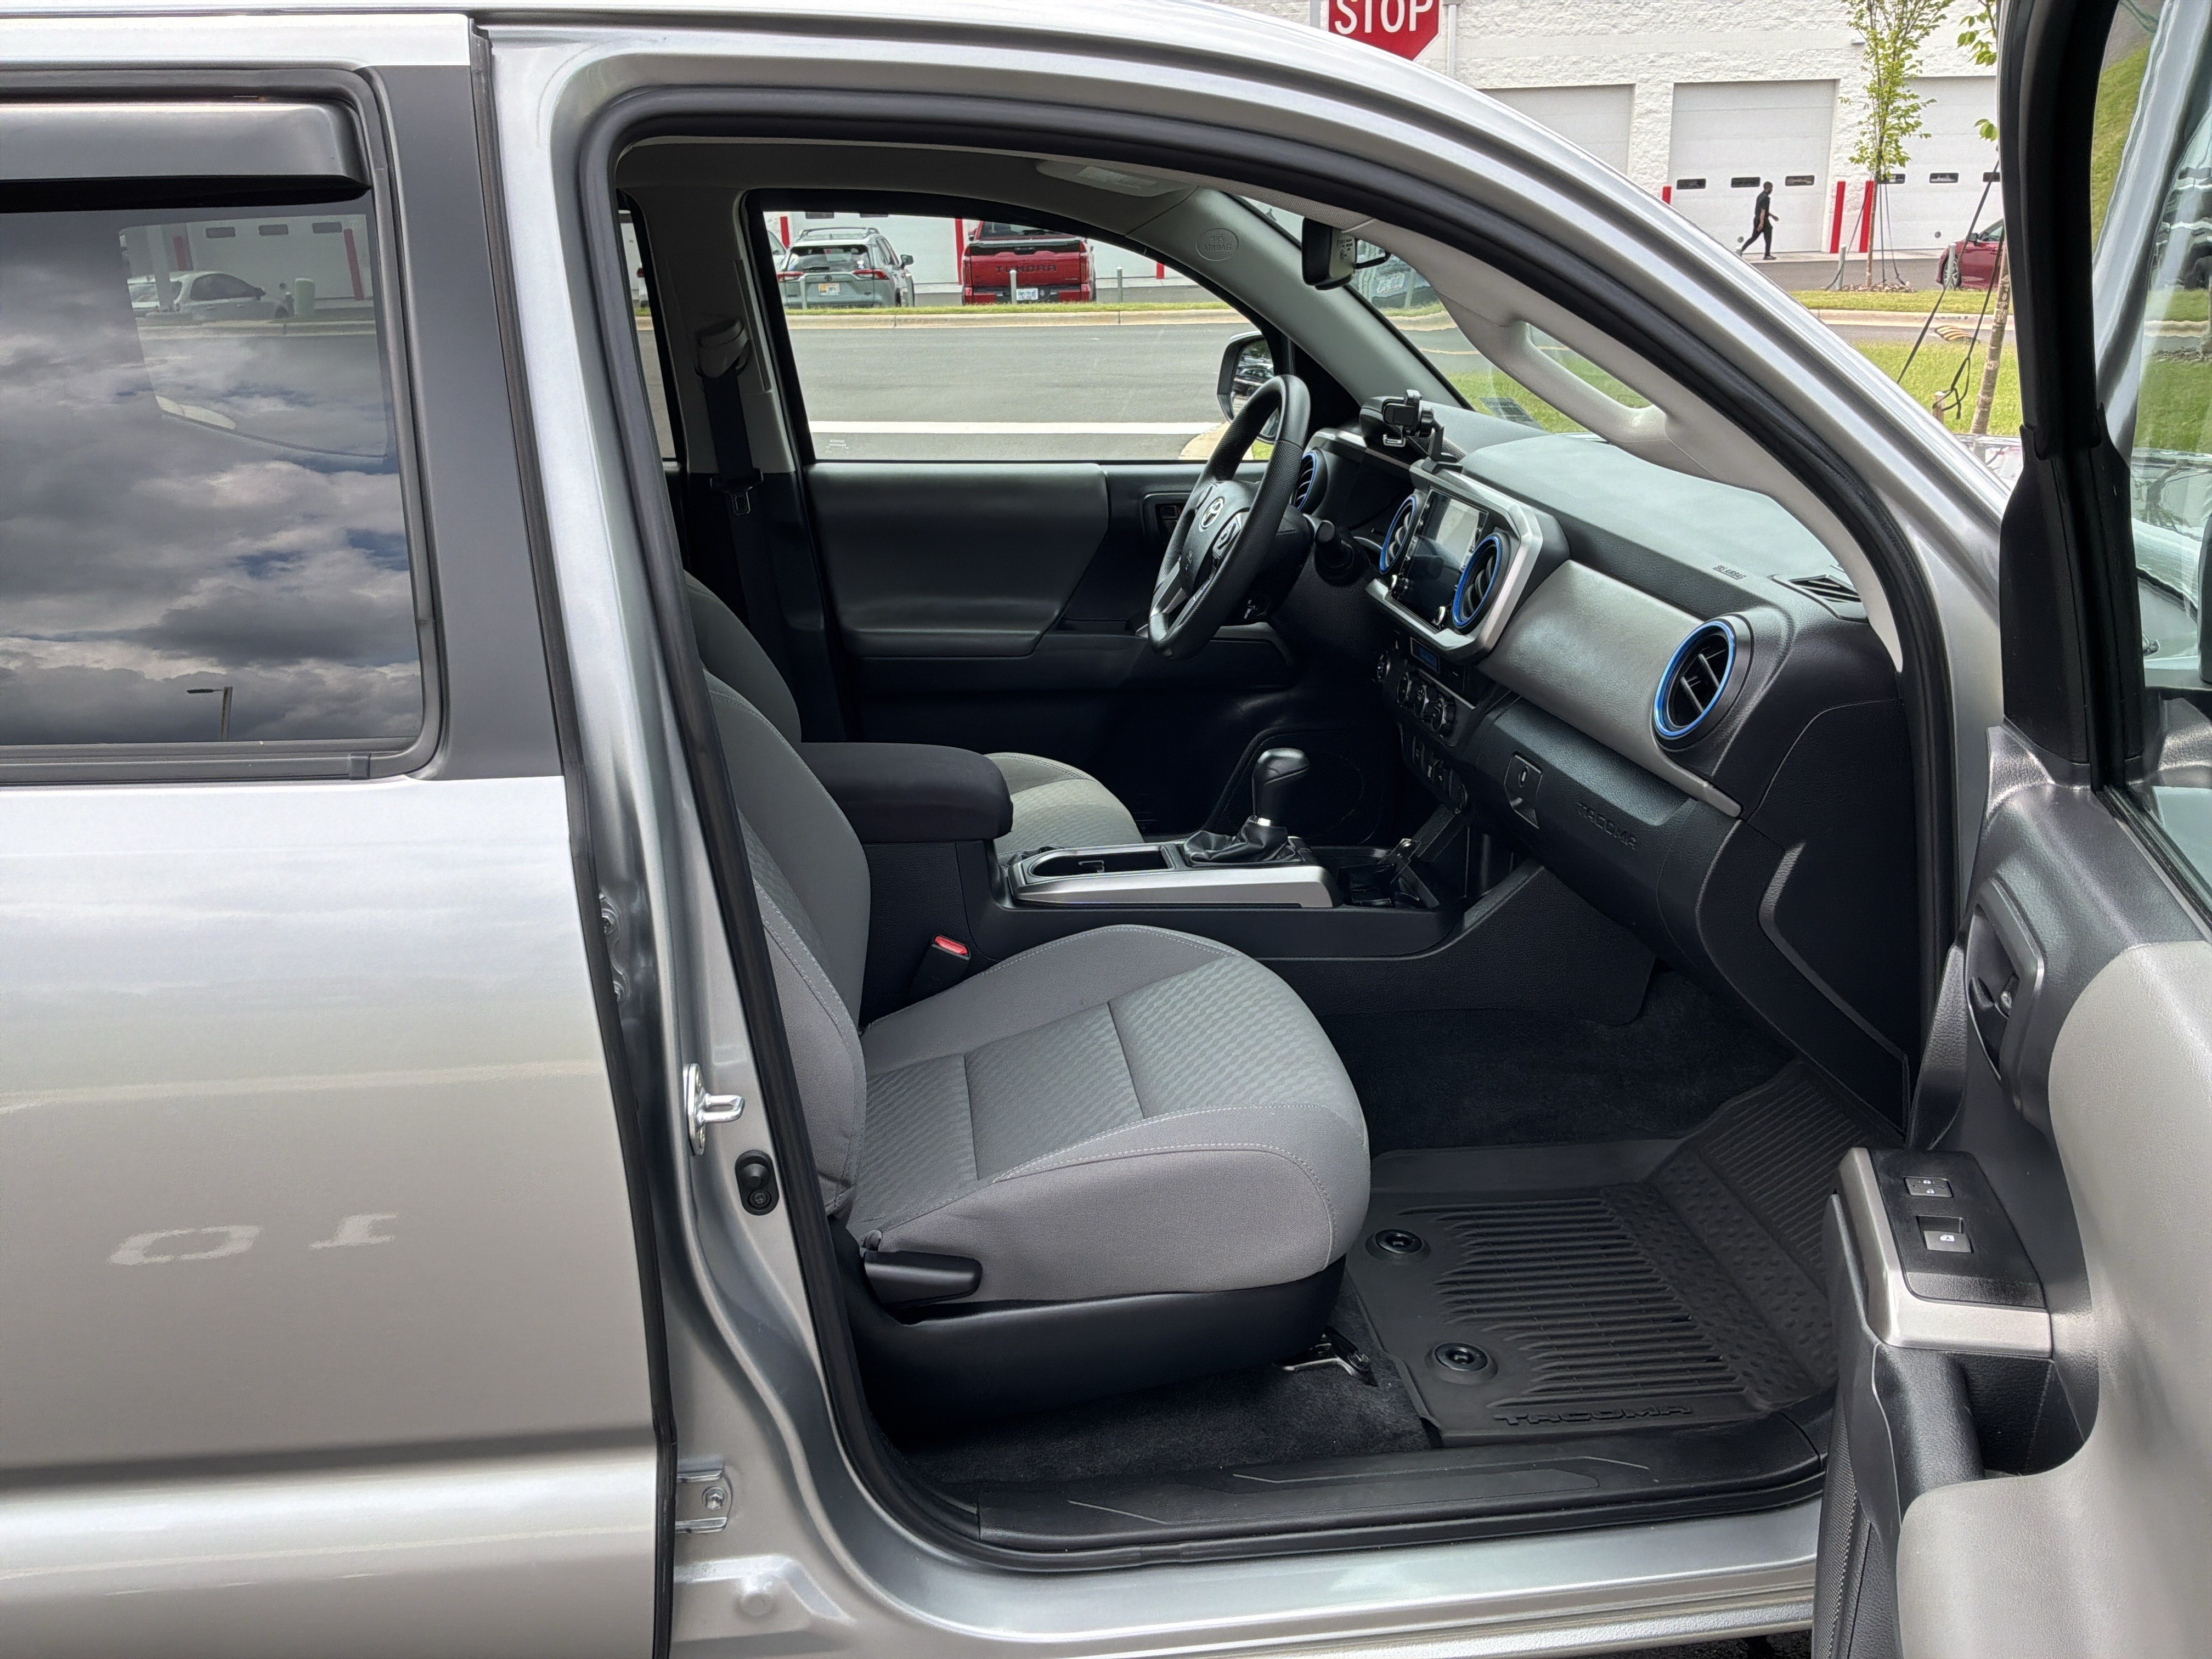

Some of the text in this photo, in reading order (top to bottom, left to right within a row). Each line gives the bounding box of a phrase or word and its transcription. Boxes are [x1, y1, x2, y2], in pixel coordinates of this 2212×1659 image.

[1334, 0, 1433, 35] STOP
[995, 264, 1057, 273] TUNDRA
[1493, 1405, 1692, 1426] TACOMA
